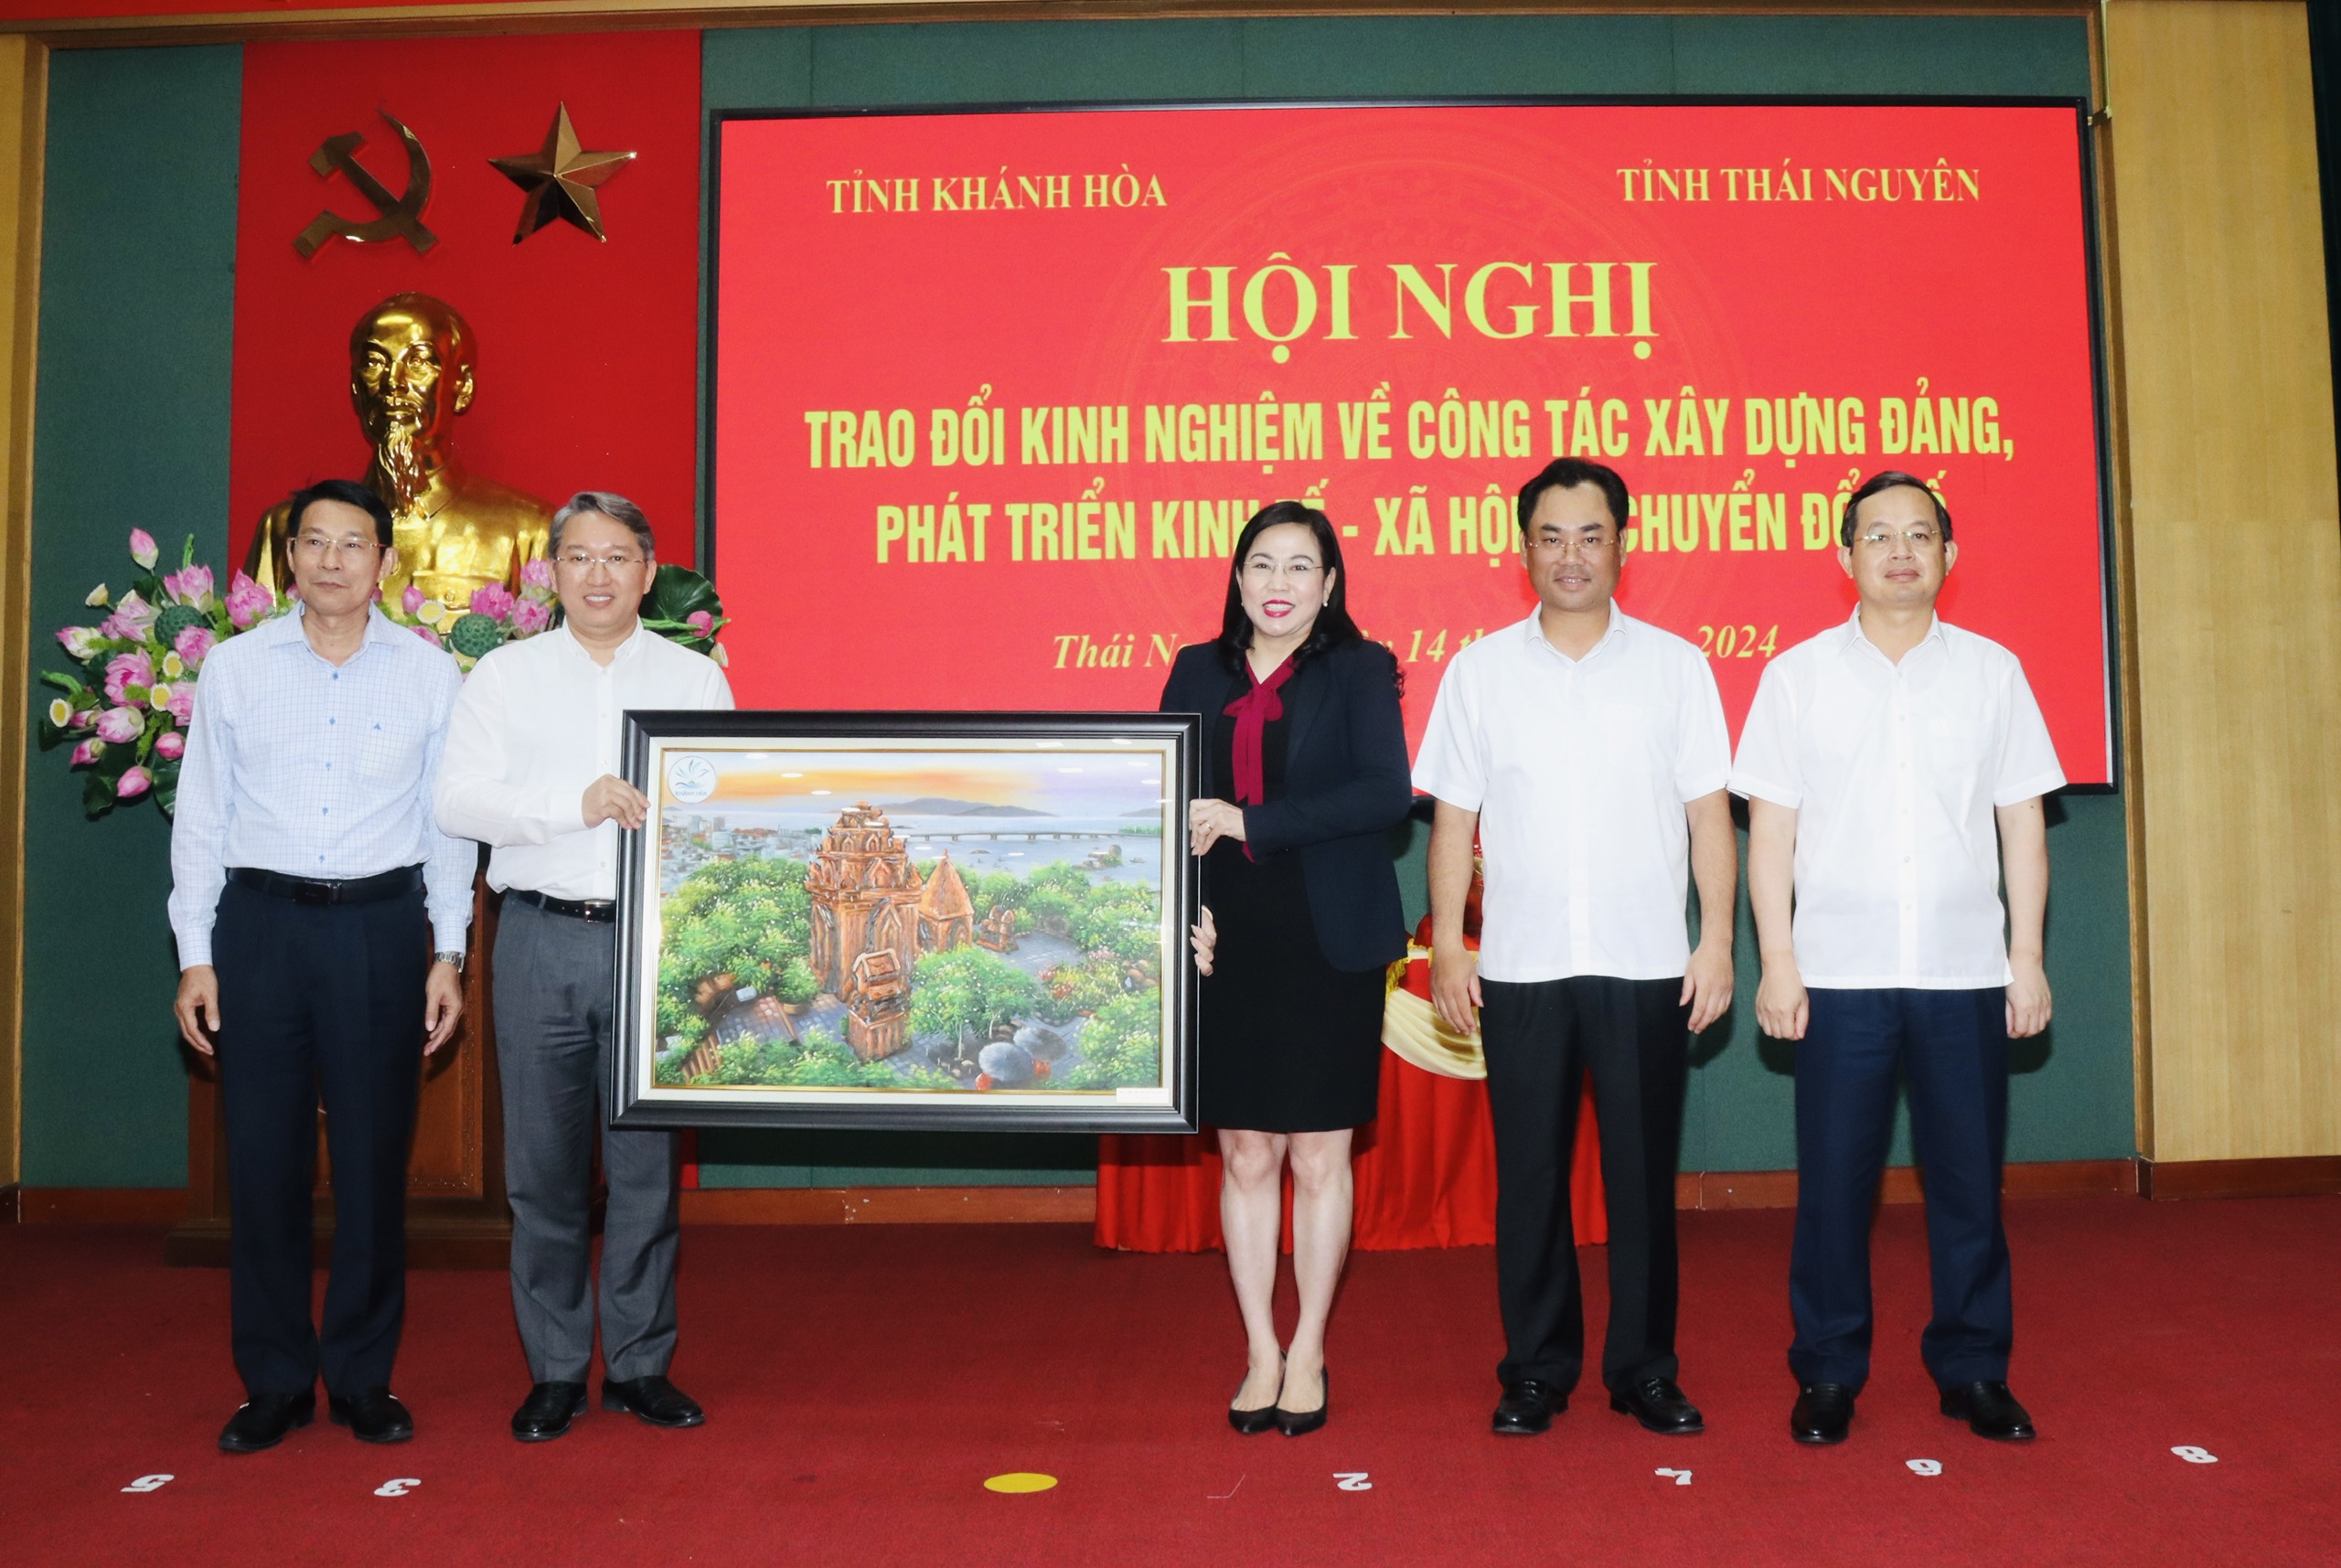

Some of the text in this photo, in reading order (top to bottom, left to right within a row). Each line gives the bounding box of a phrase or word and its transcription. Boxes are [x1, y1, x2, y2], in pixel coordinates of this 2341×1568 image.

[827, 163, 1168, 214] TỈNH KHÁNH HÒA
[1616, 157, 1979, 202] TỈNH THÁI NGUYÊN
[1160, 251, 1660, 365] HỘI NGHỊ
[804, 376, 2015, 475] TRAO ĐỔI KINH NGHIỆM VỀ CÔNG TÁC XÂY DỰNG ĐẢNG,
[876, 491, 992, 564] PHÁT
[1004, 475, 1137, 562] TRIỂN
[1151, 499, 1259, 560] KINH
[1374, 485, 1436, 557] XÃ
[1801, 467, 1862, 551] ĐỔ
[1053, 633, 1136, 669] Thái
[1405, 628, 1448, 663] 14
[1698, 624, 1780, 659] 2024
[2170, 1445, 2218, 1464] 8
[121, 1474, 175, 1492] 5
[373, 1478, 422, 1497] 3
[1332, 1472, 1373, 1491] 2
